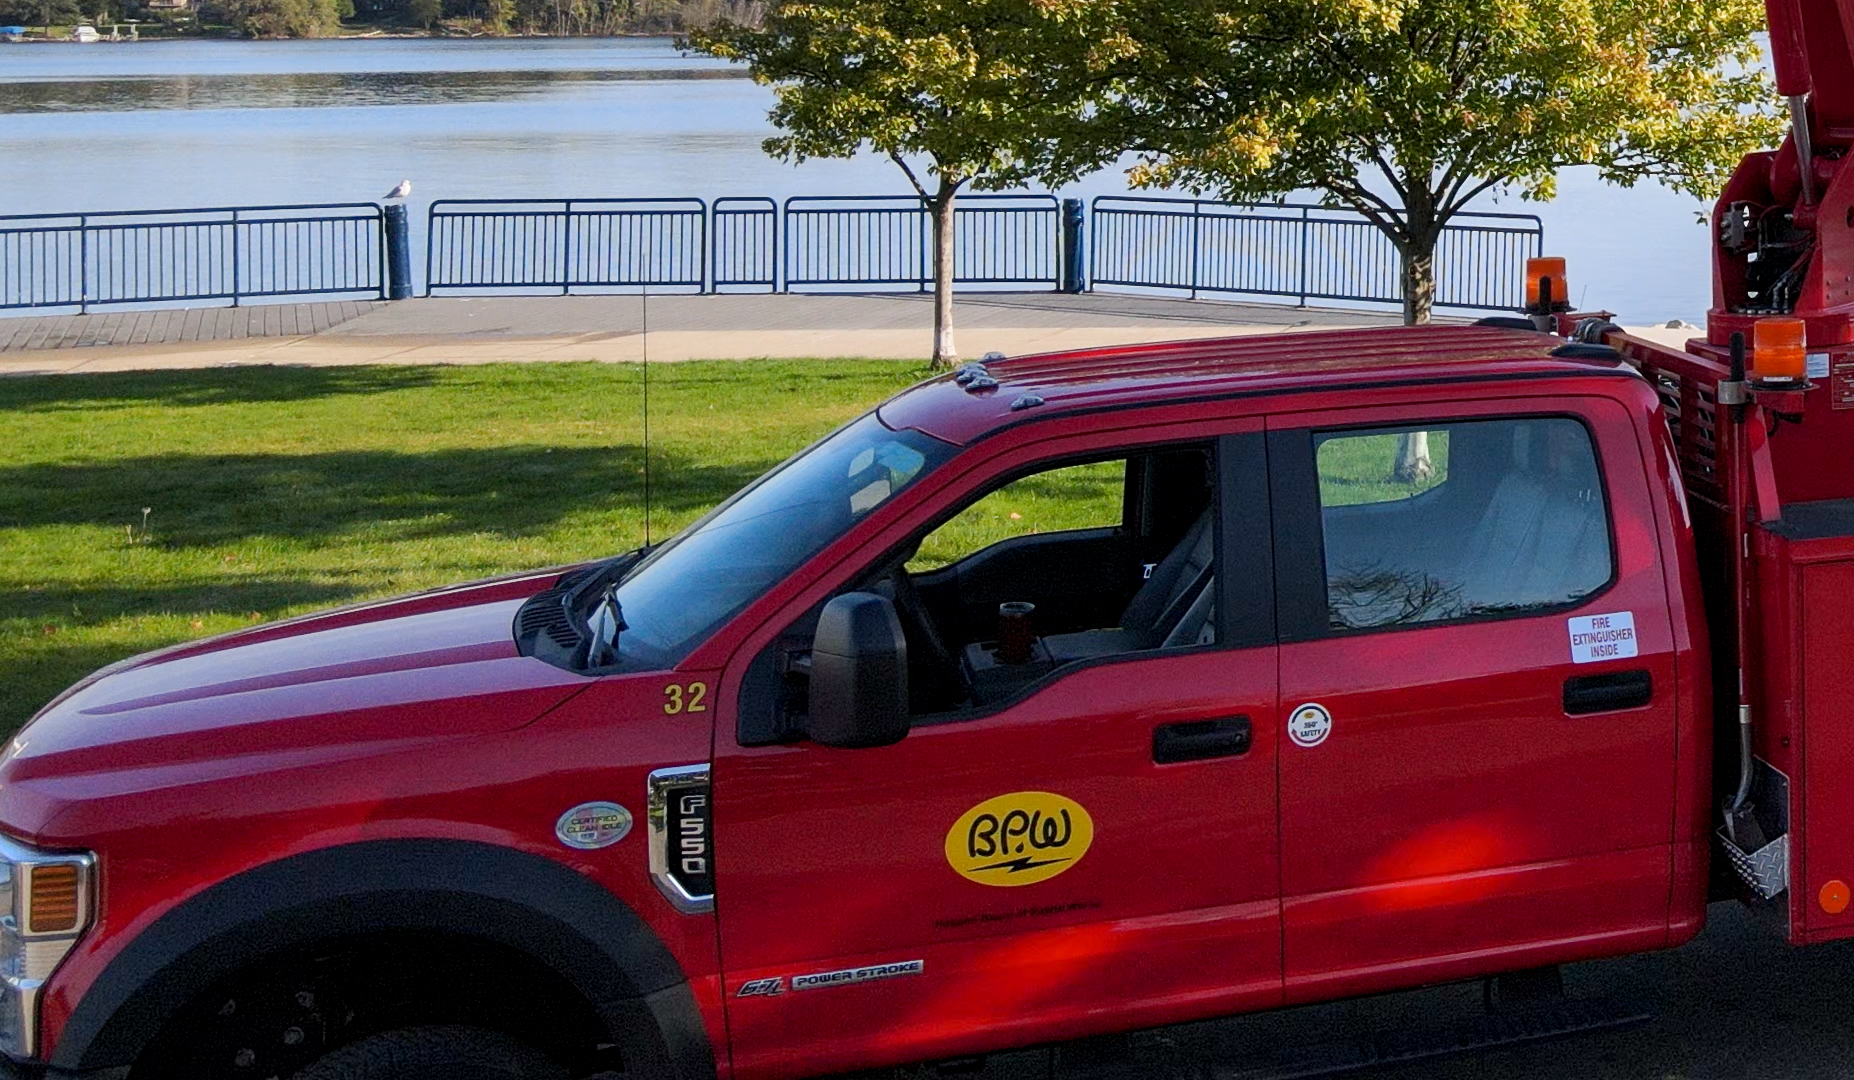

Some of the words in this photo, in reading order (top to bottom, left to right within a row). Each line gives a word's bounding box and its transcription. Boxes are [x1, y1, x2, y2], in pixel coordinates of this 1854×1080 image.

[1592, 617, 1610, 629] FIRE
[1573, 628, 1633, 645] EXTINGUISHER
[1591, 644, 1618, 657] INSIDE
[664, 682, 706, 714] 32
[680, 794, 706, 874] F550
[797, 971, 851, 986] POWER
[855, 962, 919, 978] STROKE
